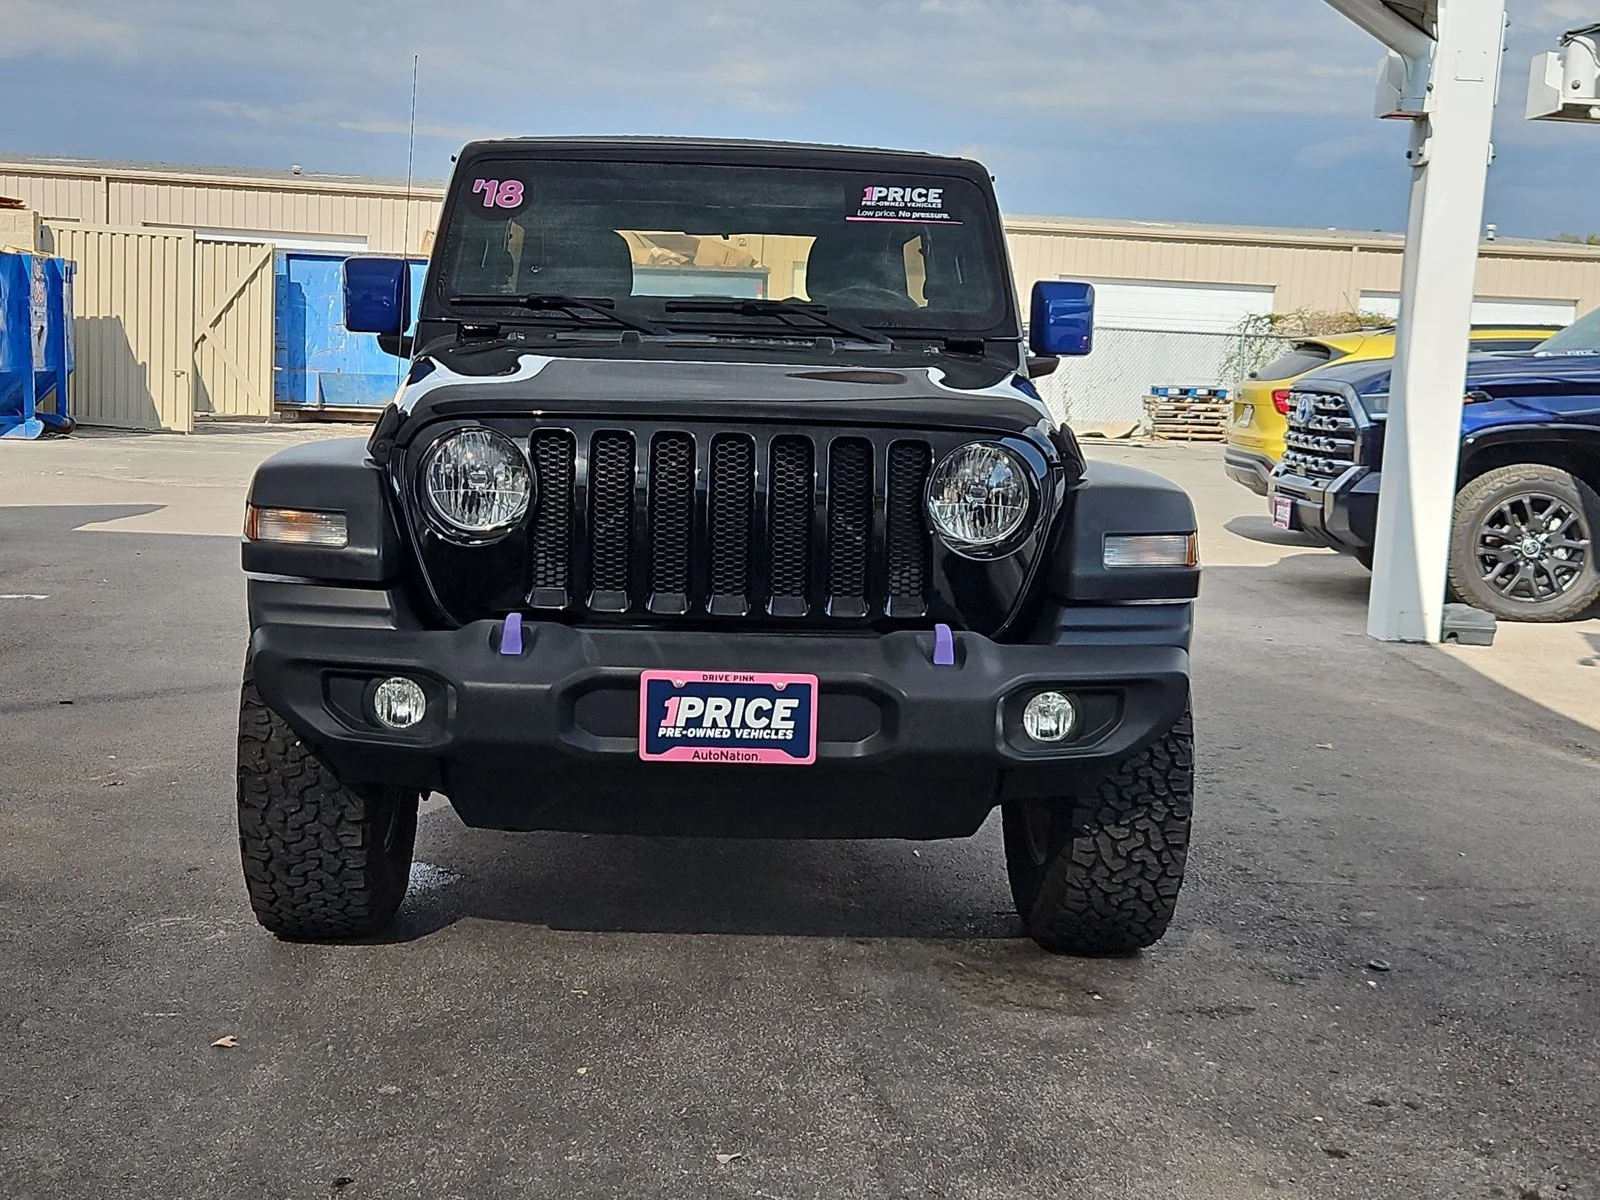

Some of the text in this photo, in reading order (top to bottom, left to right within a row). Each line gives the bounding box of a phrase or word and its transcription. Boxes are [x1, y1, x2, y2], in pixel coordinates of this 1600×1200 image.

[472, 179, 525, 208] '18
[862, 186, 943, 203] 1PRICE
[857, 209, 951, 219] Low price. No pressure.
[702, 674, 730, 682] DRIVE
[660, 696, 799, 729] 1PRICE
[658, 727, 794, 740] PRE-OWNED VEHICLES
